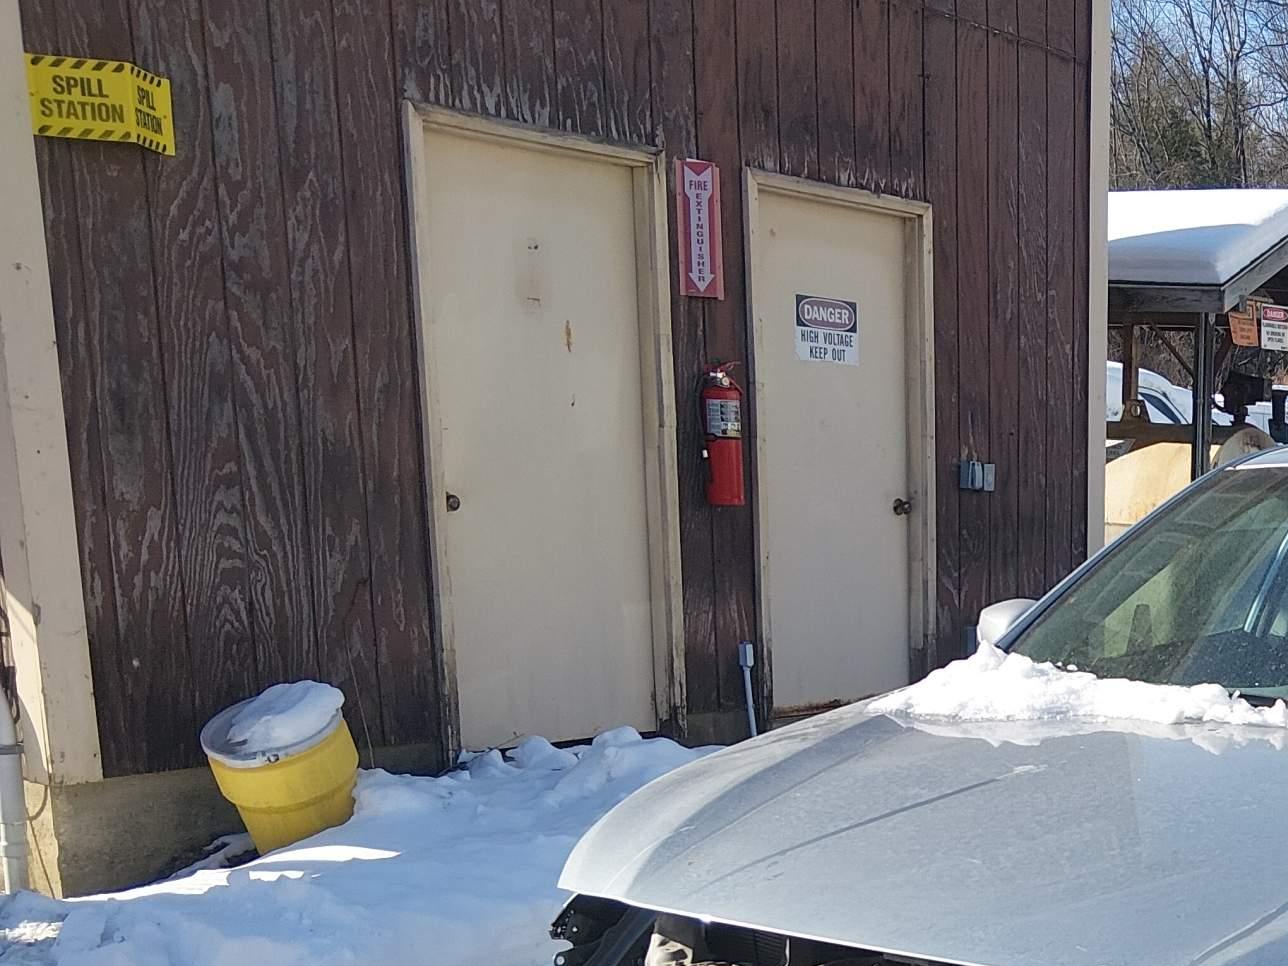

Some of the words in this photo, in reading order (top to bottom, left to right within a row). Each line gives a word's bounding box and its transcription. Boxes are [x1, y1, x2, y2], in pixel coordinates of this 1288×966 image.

[52, 74, 109, 98] SPILL
[136, 85, 156, 111] SPILL
[40, 97, 125, 124] STATION
[135, 107, 163, 136] STATION
[688, 179, 709, 192] FIRE
[695, 192, 706, 283] EXTINGUISHER
[804, 303, 849, 325] DANGER
[800, 329, 819, 344] HIGH
[822, 332, 854, 348] VOLTAGE
[809, 345, 828, 360] KEEP
[831, 347, 846, 362] OUT
